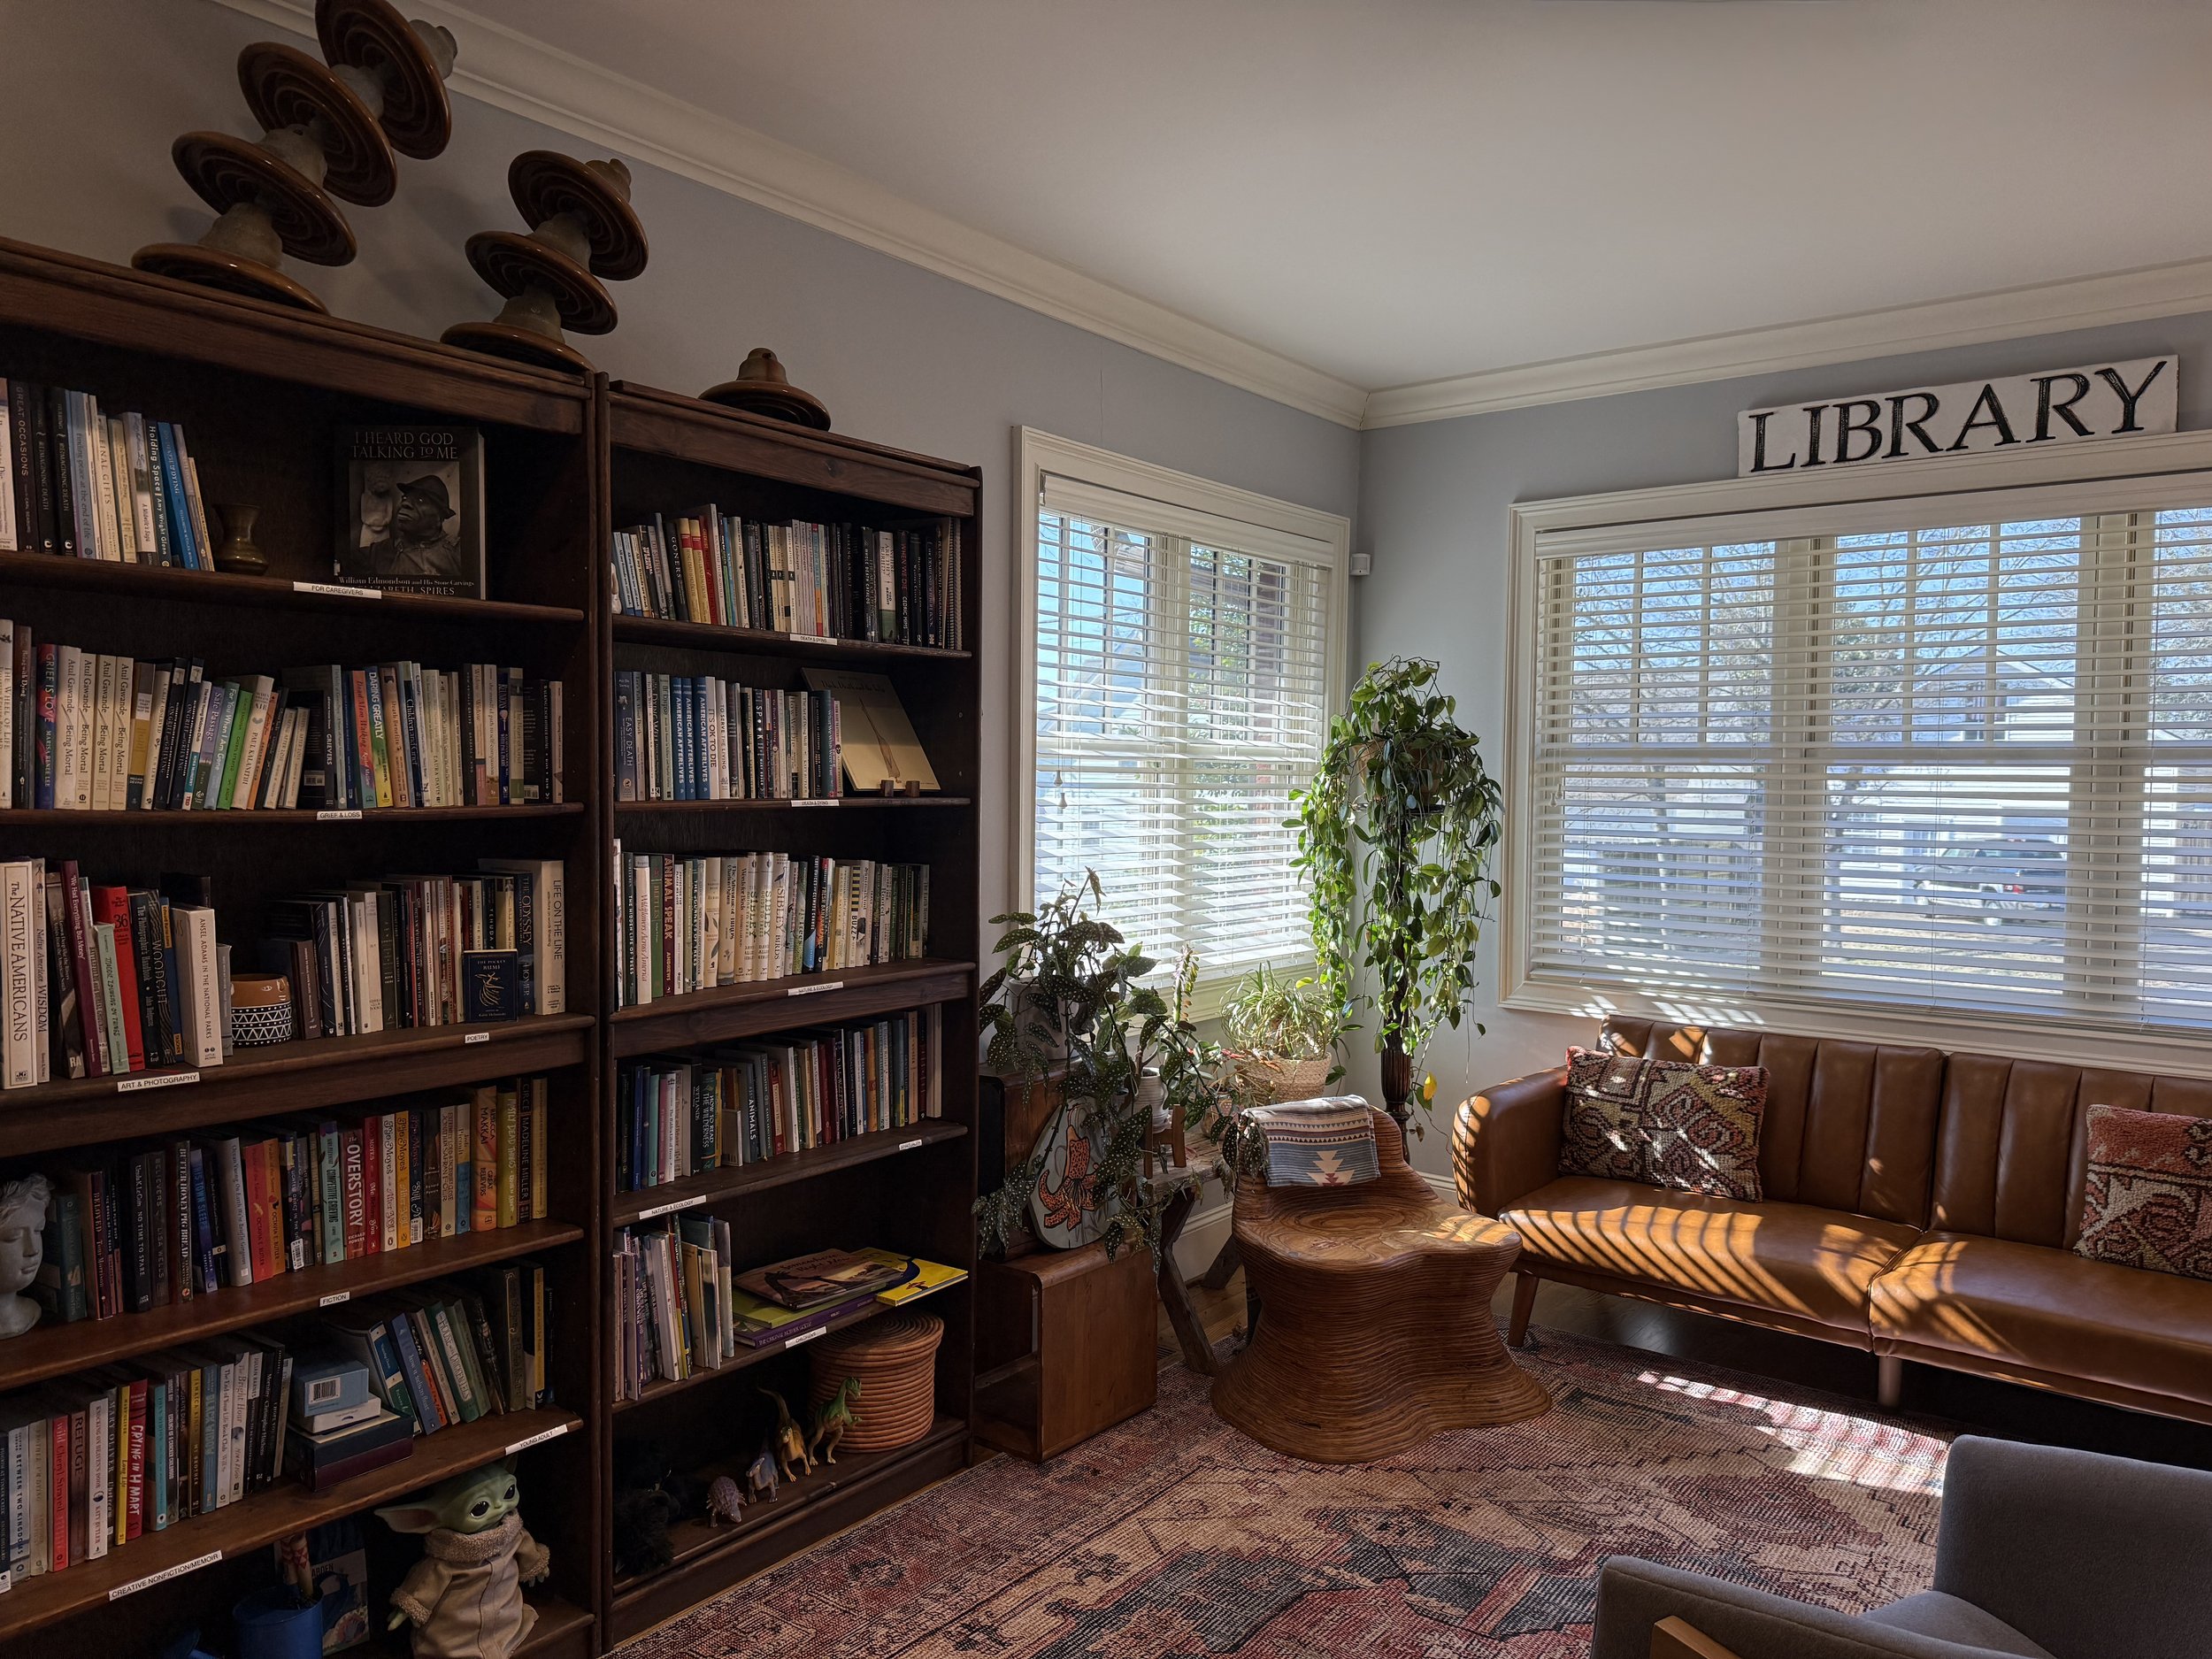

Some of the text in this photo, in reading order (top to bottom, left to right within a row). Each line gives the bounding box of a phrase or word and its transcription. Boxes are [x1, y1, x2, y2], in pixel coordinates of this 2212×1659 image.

[1748, 361, 2168, 472] LIBRARY
[355, 432, 454, 445] I HEARD GOD
[148, 426, 161, 491] Holding Space
[351, 445, 415, 458] TALKING
[437, 446, 458, 459] ME
[158, 514, 166, 534] Wright
[671, 536, 682, 578] GONERS
[326, 586, 364, 595] CAREGIVERS
[419, 586, 456, 595] SPIRES
[45, 653, 55, 722] GRIEF IS LOVE
[82, 678, 91, 712] Gawande
[101, 679, 110, 713] Gawande
[207, 692, 222, 741] Safe Passage
[369, 672, 383, 739] DARING GREATLY
[222, 714, 231, 733] When
[709, 725, 716, 737] OK
[64, 725, 73, 746] Being
[79, 725, 89, 745] Being
[99, 725, 108, 746] Being
[116, 727, 126, 748] Being
[219, 739, 226, 751] Am
[710, 739, 716, 751] TO
[99, 748, 107, 773] Mortal
[215, 753, 224, 770] Gone
[553, 880, 562, 897] LIFE
[664, 858, 673, 939] ANIMAL SPEAK
[553, 901, 562, 916] ON
[639, 894, 649, 931] Wildflowers
[749, 891, 758, 937] SIBLEY
[113, 914, 128, 929] 36
[774, 888, 785, 960] SIBLEY BIRDS
[200, 940, 208, 963] ADAMS
[554, 940, 562, 960] LINE
[10, 882, 27, 1041] The NATIVE AMERICANS
[37, 952, 45, 981] American
[152, 940, 167, 1004] WOODCUT
[38, 985, 47, 1032] WISDOM
[203, 988, 212, 1018] NATIONAL
[144, 1075, 197, 1087] PHOTOGRAPHY
[748, 1099, 756, 1140] ANIMALS
[346, 1145, 363, 1226] OVERSTORY
[521, 1167, 529, 1199] MILLER
[137, 1211, 143, 1222] NO
[651, 1206, 669, 1215] NATURE
[673, 1199, 694, 1210] ECOLOGY
[138, 1244, 144, 1252] TO
[779, 1254, 839, 1272] Somewhere
[797, 1256, 850, 1274] Right Now
[323, 1294, 346, 1304] FICTION
[235, 1376, 246, 1422] Bright Hour
[75, 1416, 83, 1477] REFUGE
[130, 1425, 143, 1459] CRYING
[519, 1431, 554, 1448] YOUNG ADULT
[128, 1474, 142, 1483] H
[128, 1486, 141, 1515] MART
[111, 1552, 219, 1599] CREATIVE NONFICTION/MEMOIR
